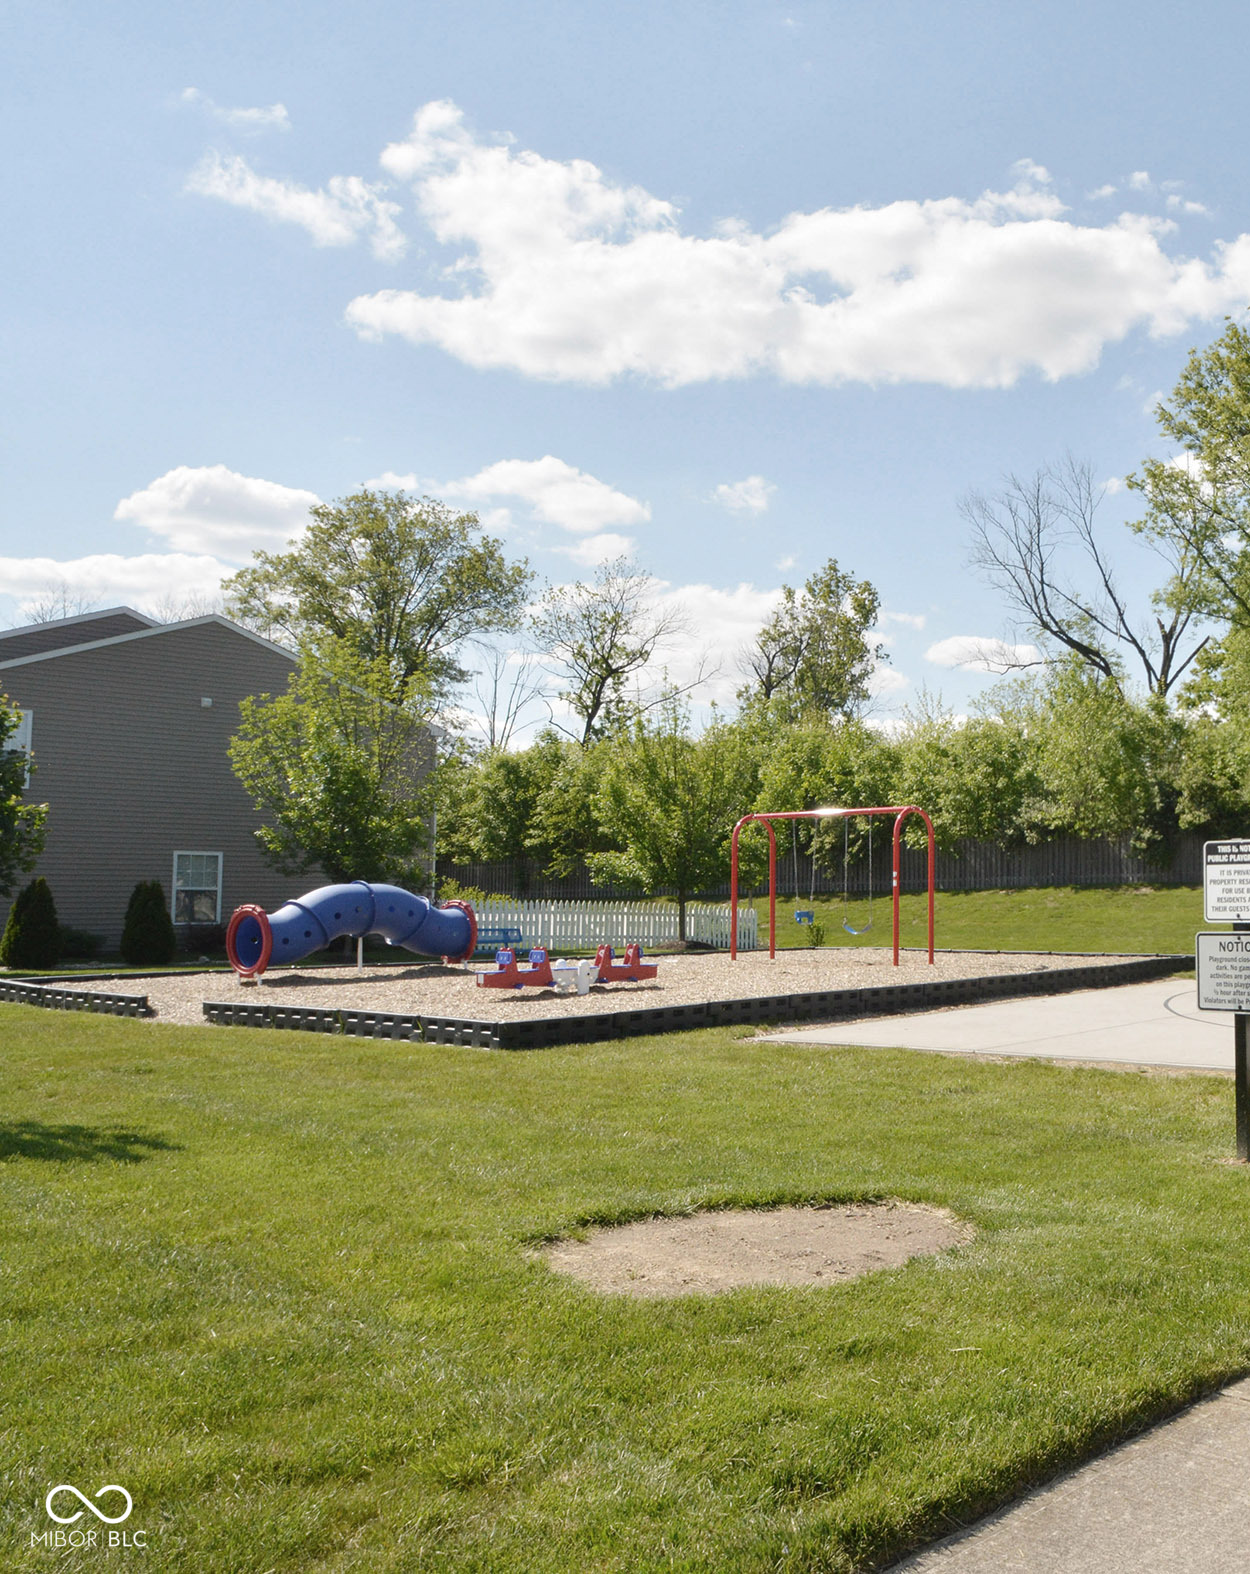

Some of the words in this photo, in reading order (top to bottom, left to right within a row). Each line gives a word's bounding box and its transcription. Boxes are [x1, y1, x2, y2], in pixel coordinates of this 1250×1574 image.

[1217, 845, 1231, 853] THIS
[1208, 854, 1228, 862] PUBLIC
[1209, 956, 1237, 964] Playground
